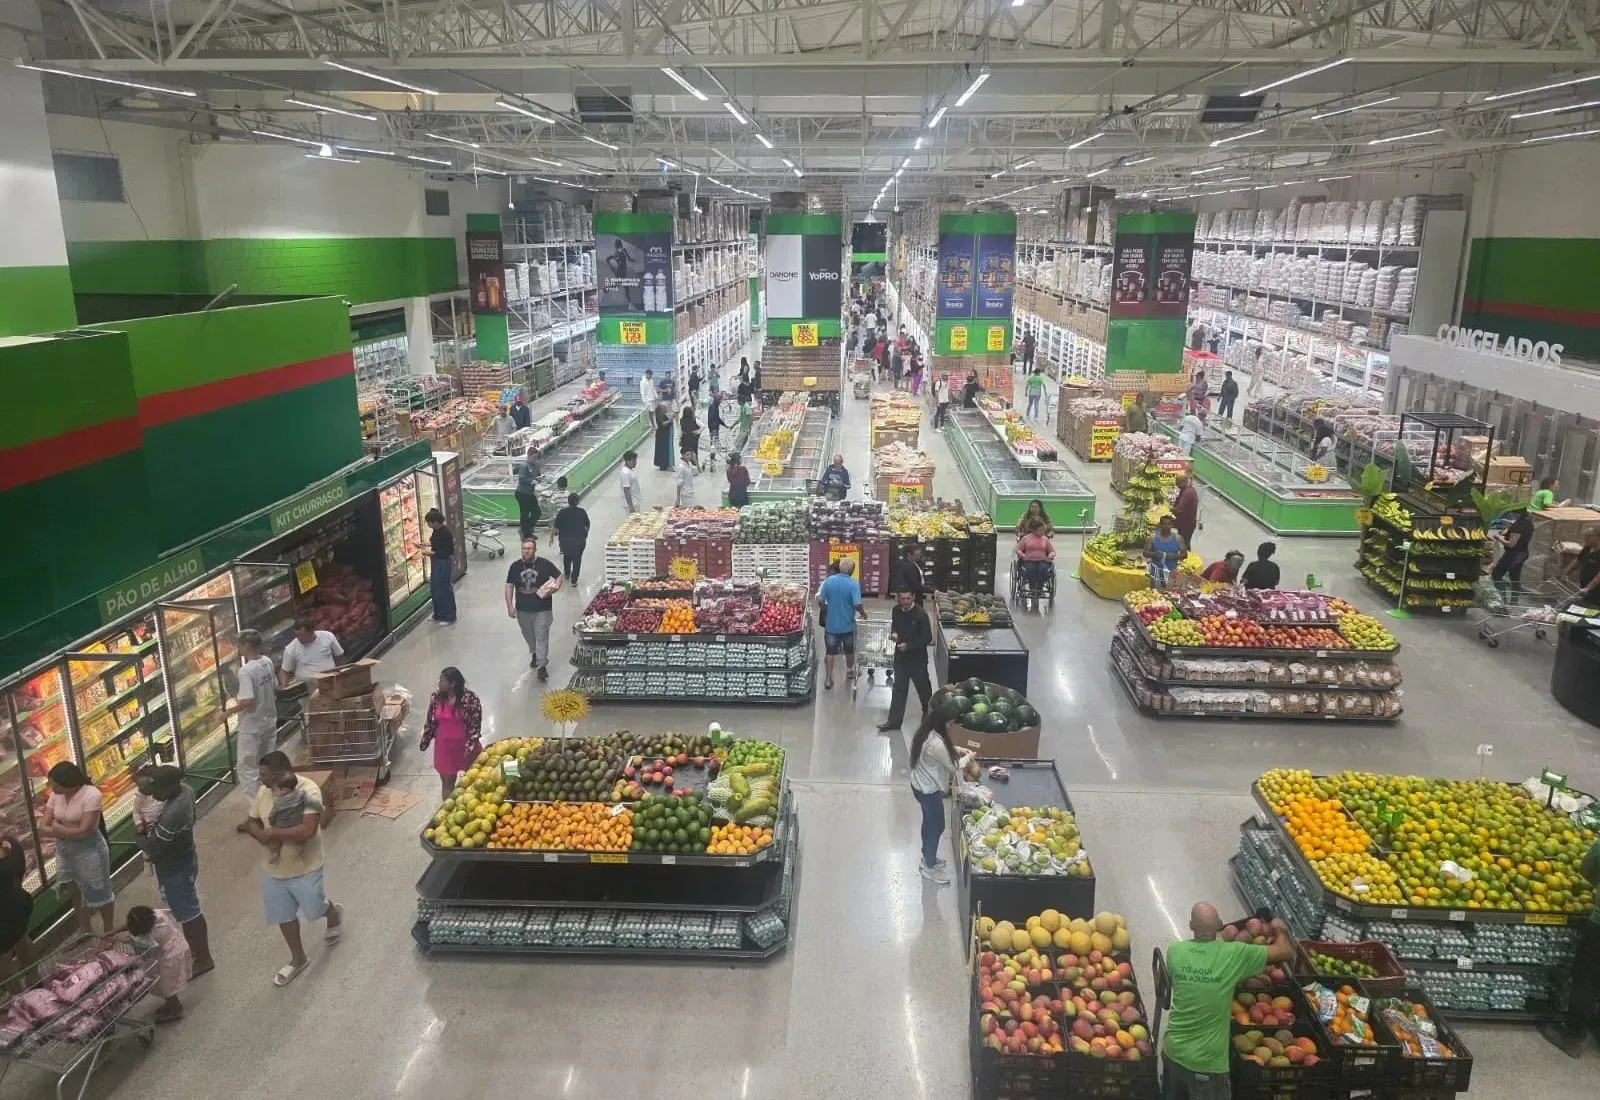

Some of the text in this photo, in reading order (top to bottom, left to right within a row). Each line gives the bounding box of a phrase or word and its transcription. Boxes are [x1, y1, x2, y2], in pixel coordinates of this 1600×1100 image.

[808, 272, 839, 281] YoPRO
[1437, 323, 1564, 367] CONGELADOS
[276, 486, 343, 528] KIT CHURRASCO
[106, 558, 198, 616] PÃO DE ALHO
